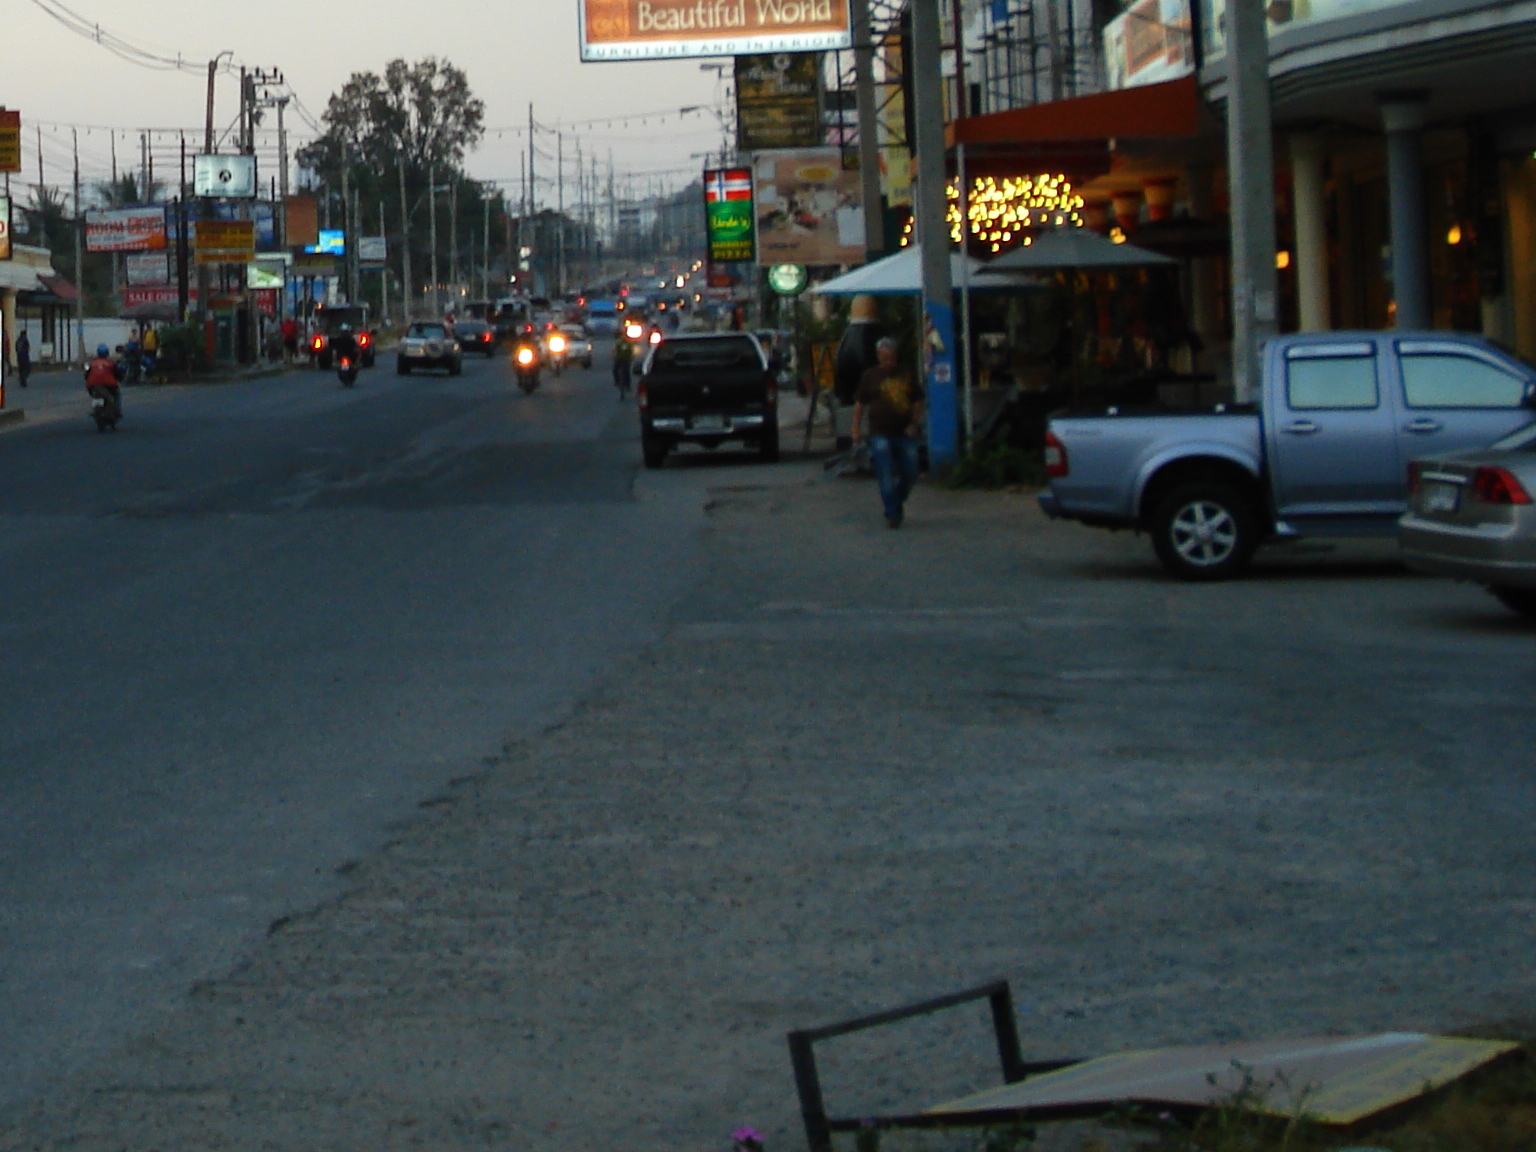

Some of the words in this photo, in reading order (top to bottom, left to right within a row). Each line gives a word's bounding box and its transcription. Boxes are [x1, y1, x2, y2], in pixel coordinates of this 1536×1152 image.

[584, 44, 687, 59] FURNITURE
[700, 41, 738, 53] AND
[746, 33, 850, 51] INTERIORS
